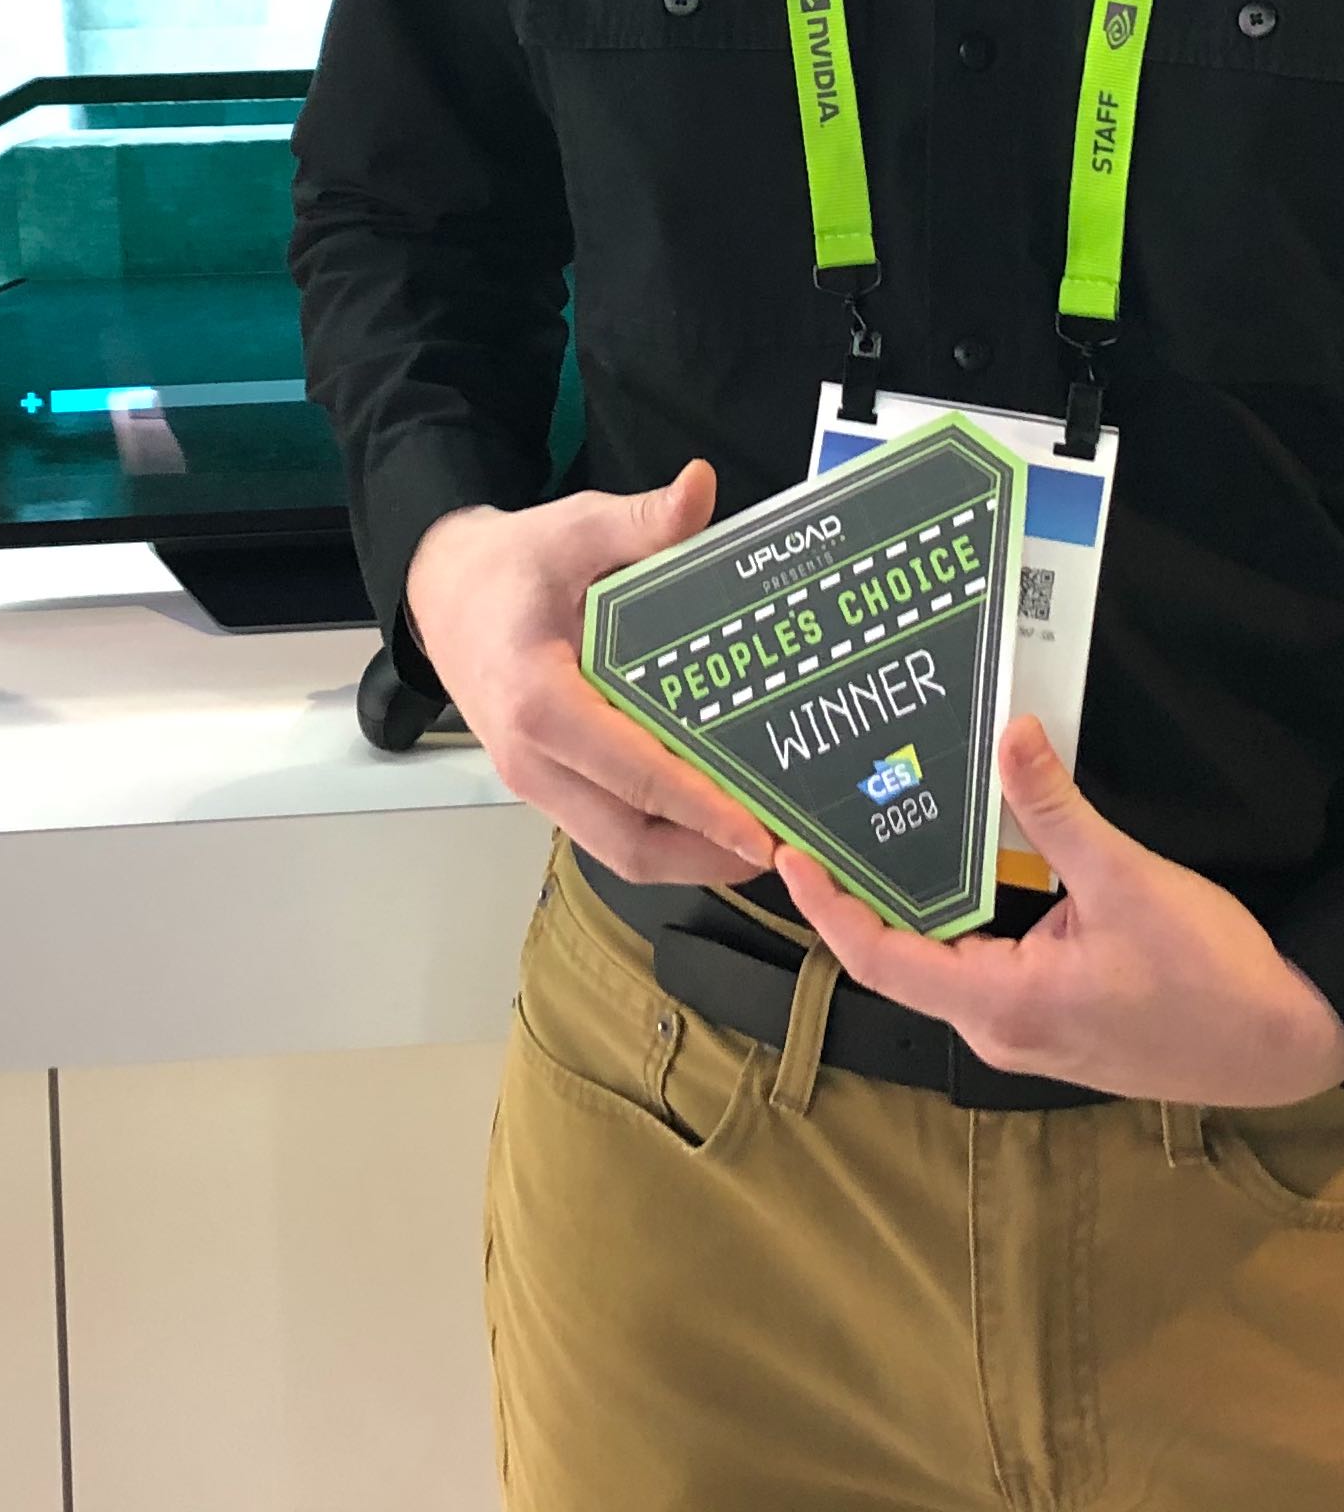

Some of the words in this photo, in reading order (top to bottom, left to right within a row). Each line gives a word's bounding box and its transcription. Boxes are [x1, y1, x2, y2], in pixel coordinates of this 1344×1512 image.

[1092, 90, 1120, 175] STAFF
[735, 514, 842, 579] UPLOAD
[762, 551, 834, 594] PRESENTS
[837, 534, 981, 626] CHOICE
[765, 648, 947, 771] WINNER
[867, 763, 912, 798] CES
[870, 790, 938, 844] 2020
